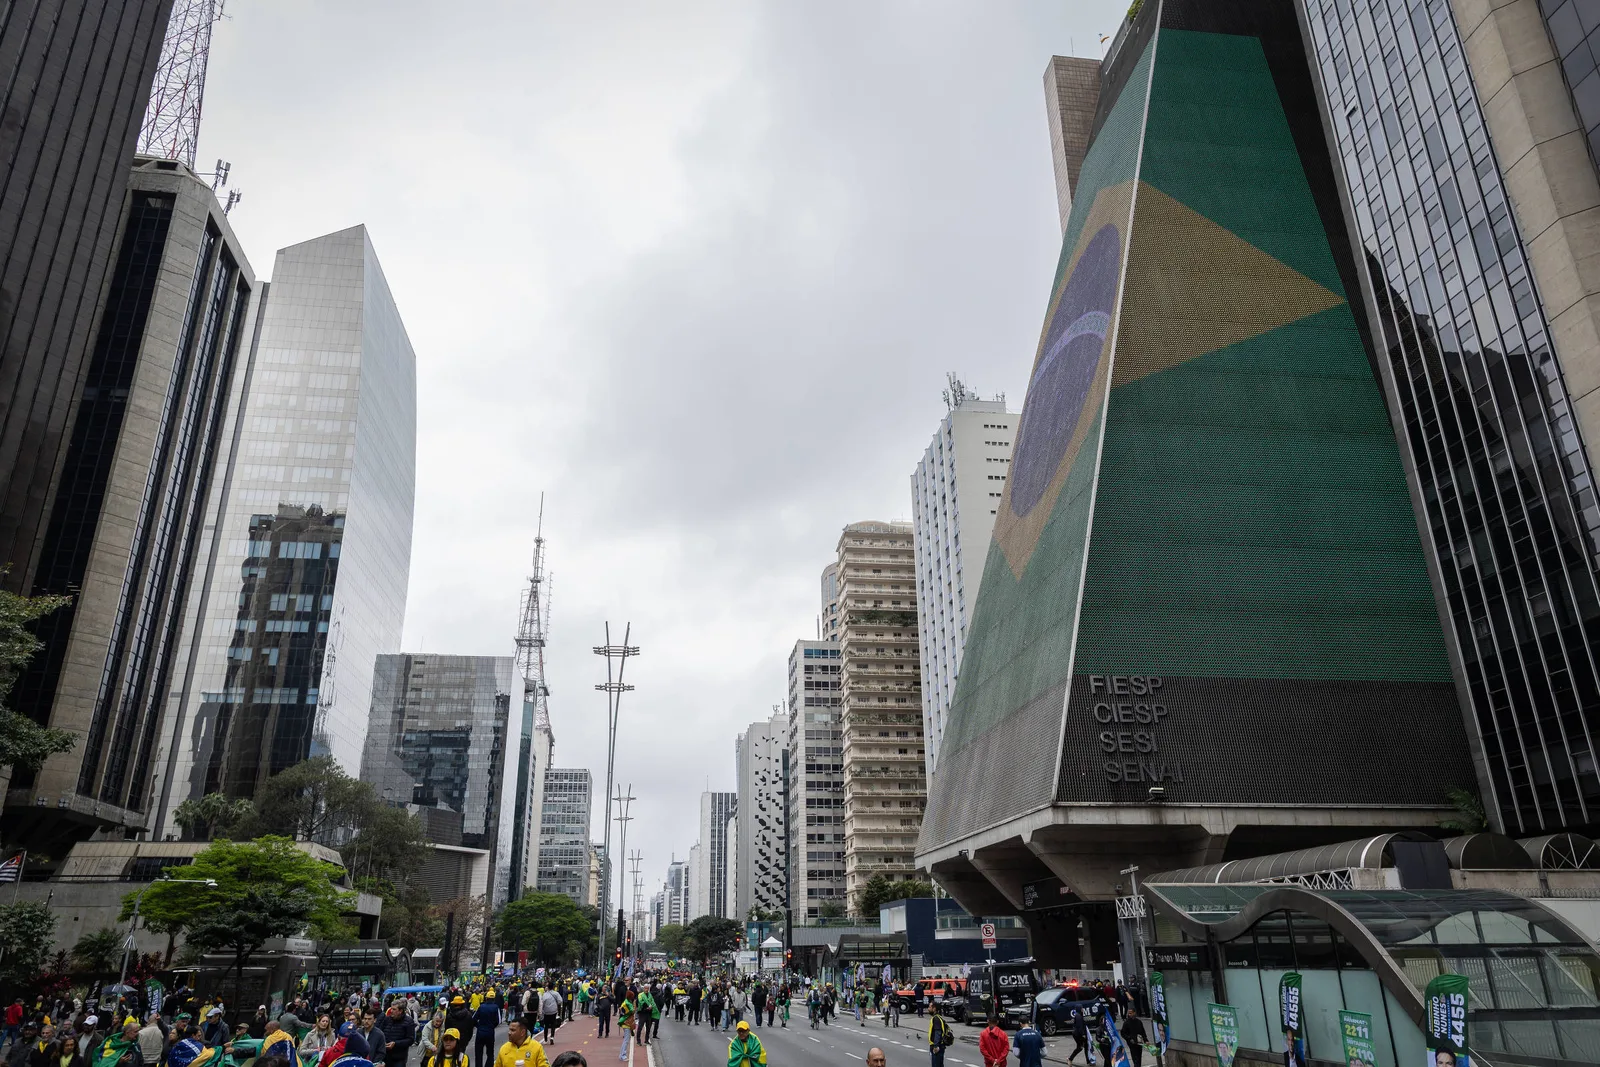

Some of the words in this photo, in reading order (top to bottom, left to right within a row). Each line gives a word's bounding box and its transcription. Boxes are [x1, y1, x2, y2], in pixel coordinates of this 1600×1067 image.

[1089, 675, 1163, 695] FIESP
[1093, 702, 1168, 724] CIESP
[1100, 731, 1158, 753] SESI
[1103, 761, 1184, 783] SENAI
[970, 979, 983, 993] GCM
[999, 974, 1030, 985] GCM
[1288, 986, 1299, 1031] 44555
[1432, 996, 1441, 1039] RUBINHO
[1439, 1003, 1448, 1034] NUNES
[1212, 1014, 1235, 1027] 2211
[1345, 1024, 1369, 1039] 2211
[1449, 993, 1465, 1048] 4455
